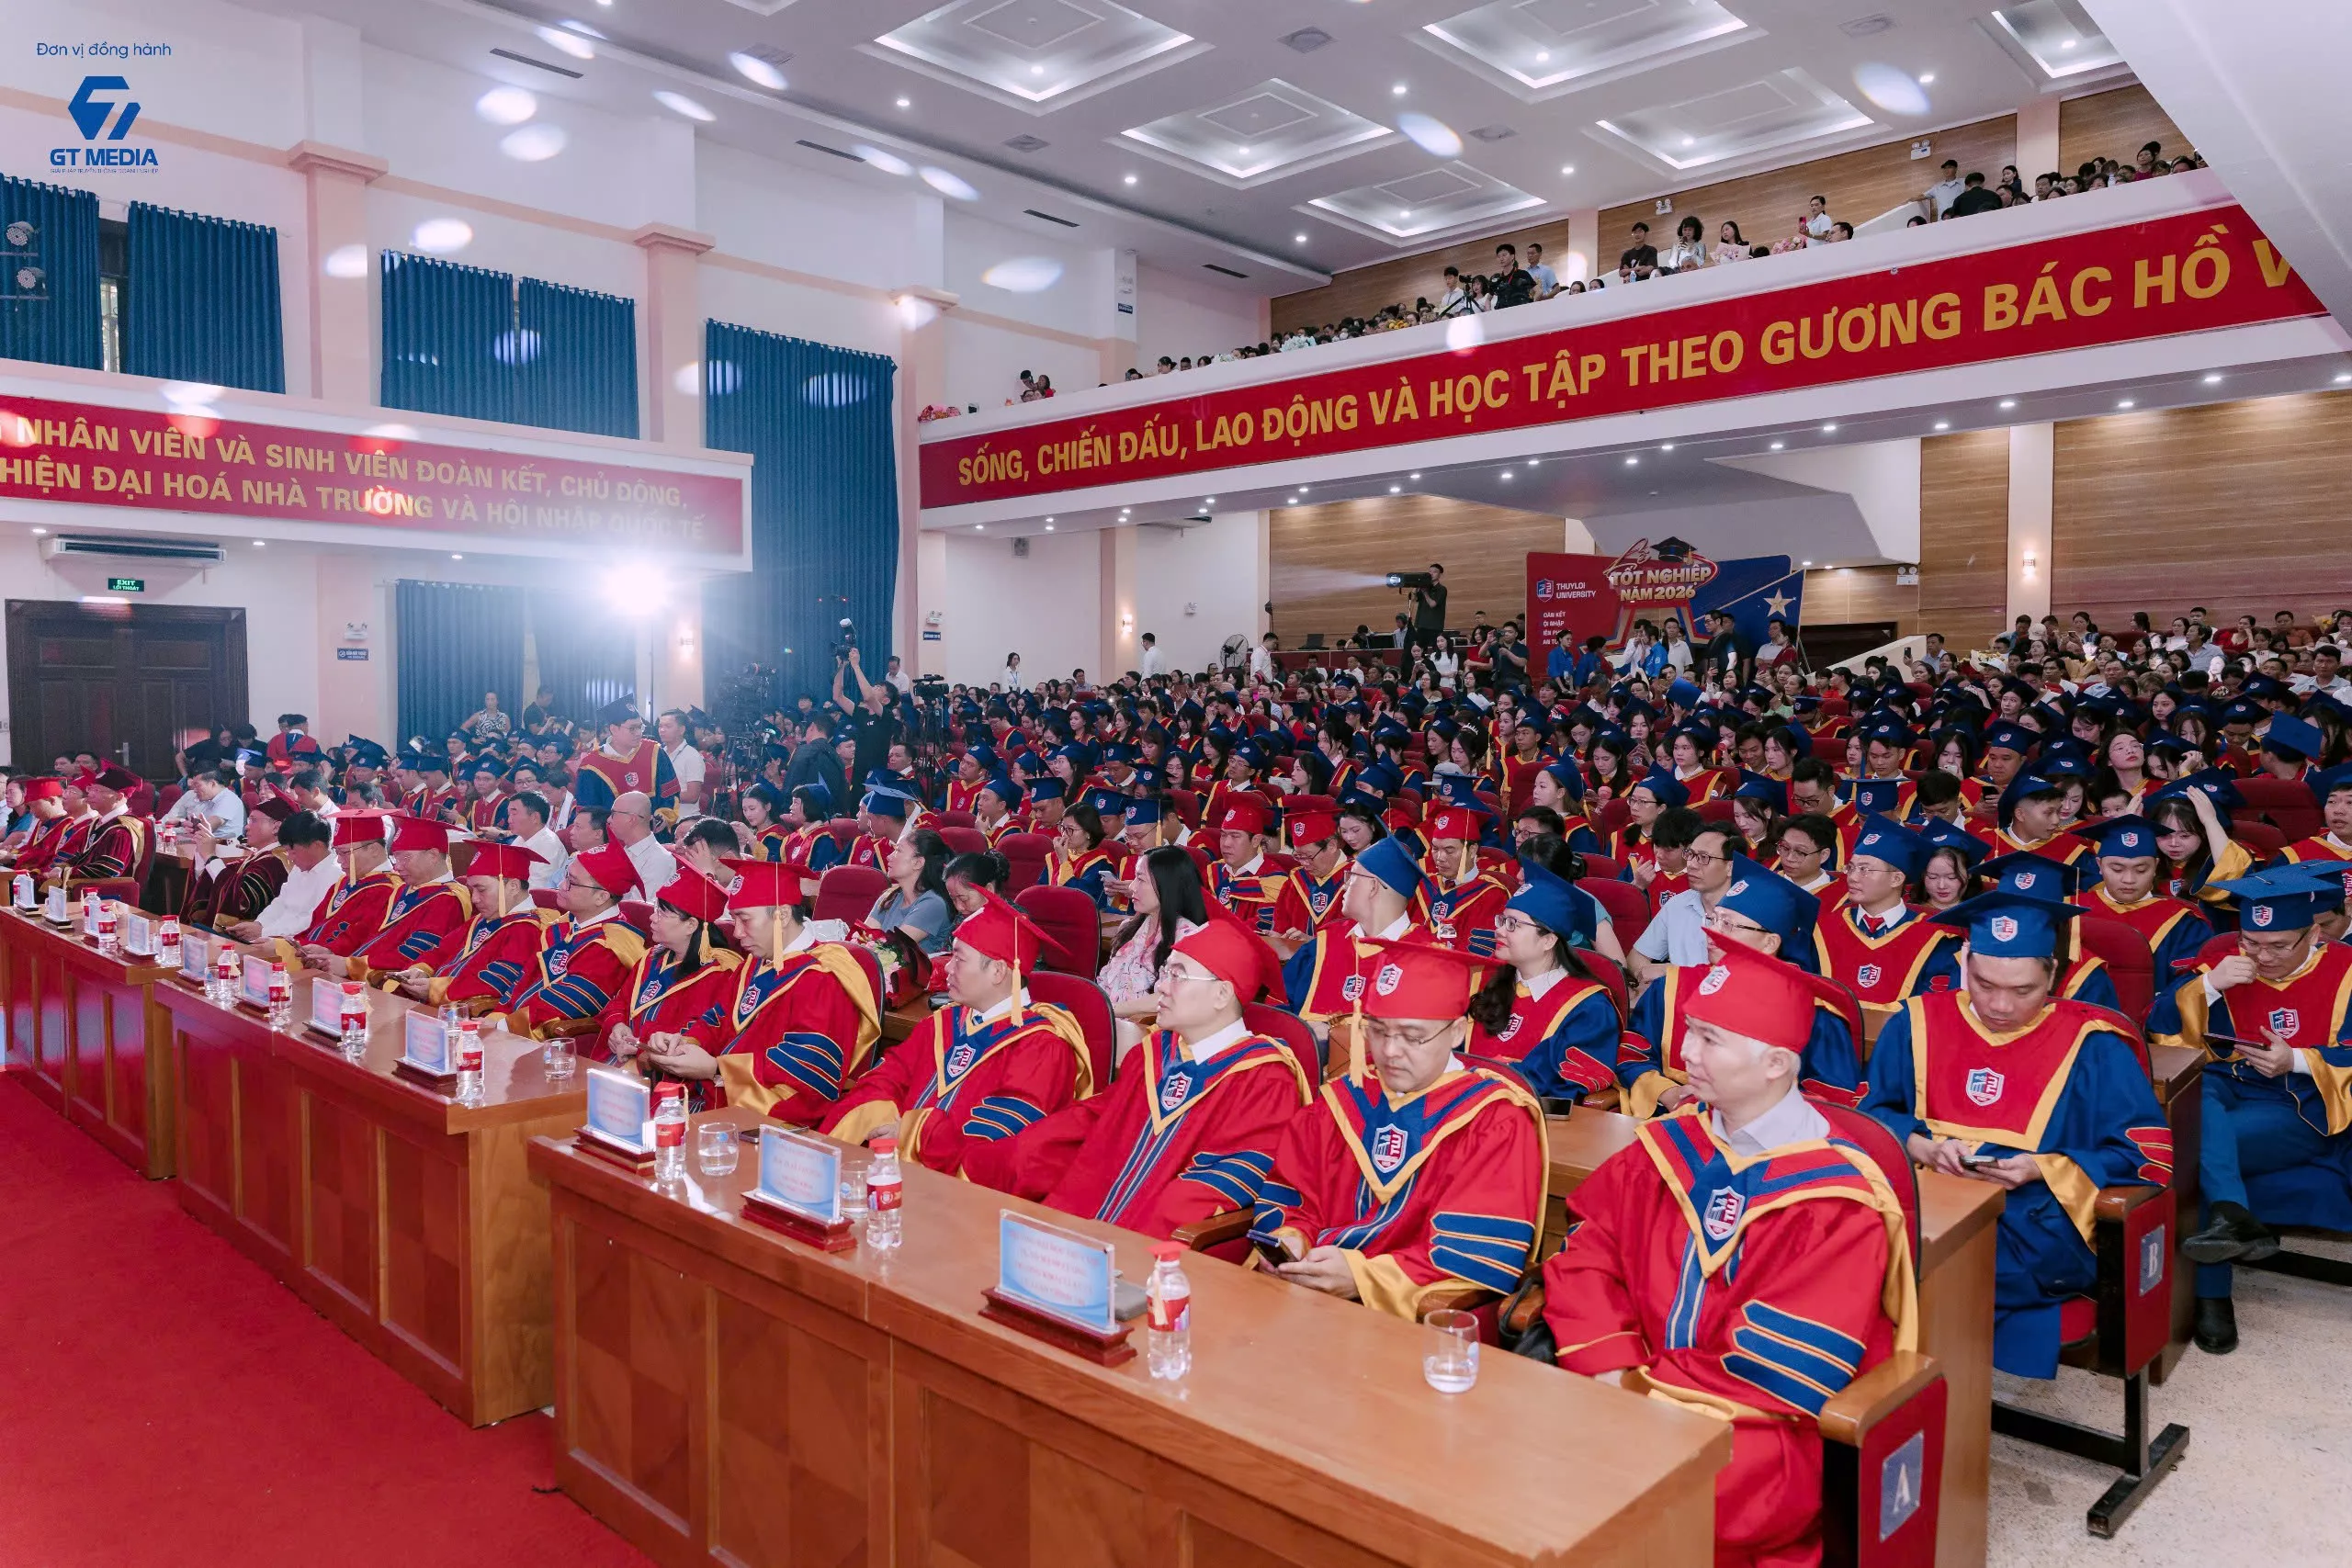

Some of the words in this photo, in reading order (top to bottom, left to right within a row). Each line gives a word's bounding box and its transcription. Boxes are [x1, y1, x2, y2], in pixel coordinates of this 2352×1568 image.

[958, 443, 1029, 487] SỐNG,
[1036, 424, 1113, 475] CHIẾN
[1118, 412, 1188, 463] ĐẤU,
[1195, 412, 1255, 451] LAO
[1261, 393, 1358, 447] ĐỘNG
[1367, 376, 1420, 425] VÀ
[1429, 369, 1510, 423] HỌC
[1521, 349, 1606, 409] TẬP
[1620, 329, 1744, 388] THEO
[1759, 292, 1962, 367] GƯƠNG
[1982, 261, 2113, 333] BÁC
[2132, 223, 2233, 310] HỒ
[17, 416, 120, 452] NHÂN
[130, 425, 207, 461] VIÊN
[215, 434, 256, 466] VÀ
[266, 444, 335, 474] SINH
[344, 449, 409, 481] VIÊN
[415, 458, 494, 491] ĐOÀN
[501, 462, 551, 499] KẾT,
[560, 470, 610, 501] CHỦ
[0, 455, 81, 494] HIỆN
[91, 466, 153, 501] ĐẠI
[164, 472, 233, 502] HOÁ
[242, 478, 308, 508] NHÀ
[316, 484, 434, 519] TRƯỜNG
[441, 491, 479, 523] VÀ
[487, 499, 528, 532] HỘI
[537, 504, 602, 536] NHẬP
[680, 513, 707, 541] TẾ
[1555, 581, 1586, 591] THUYLOI
[1555, 590, 1597, 599] UNIVERSITY
[1612, 566, 1644, 586] TỐT
[1646, 563, 1712, 588] NGHIỆP
[1620, 586, 1653, 602] NĂM
[1654, 585, 1697, 600] 2026
[2147, 1241, 2158, 1279] B
[1894, 1462, 1911, 1515] A
